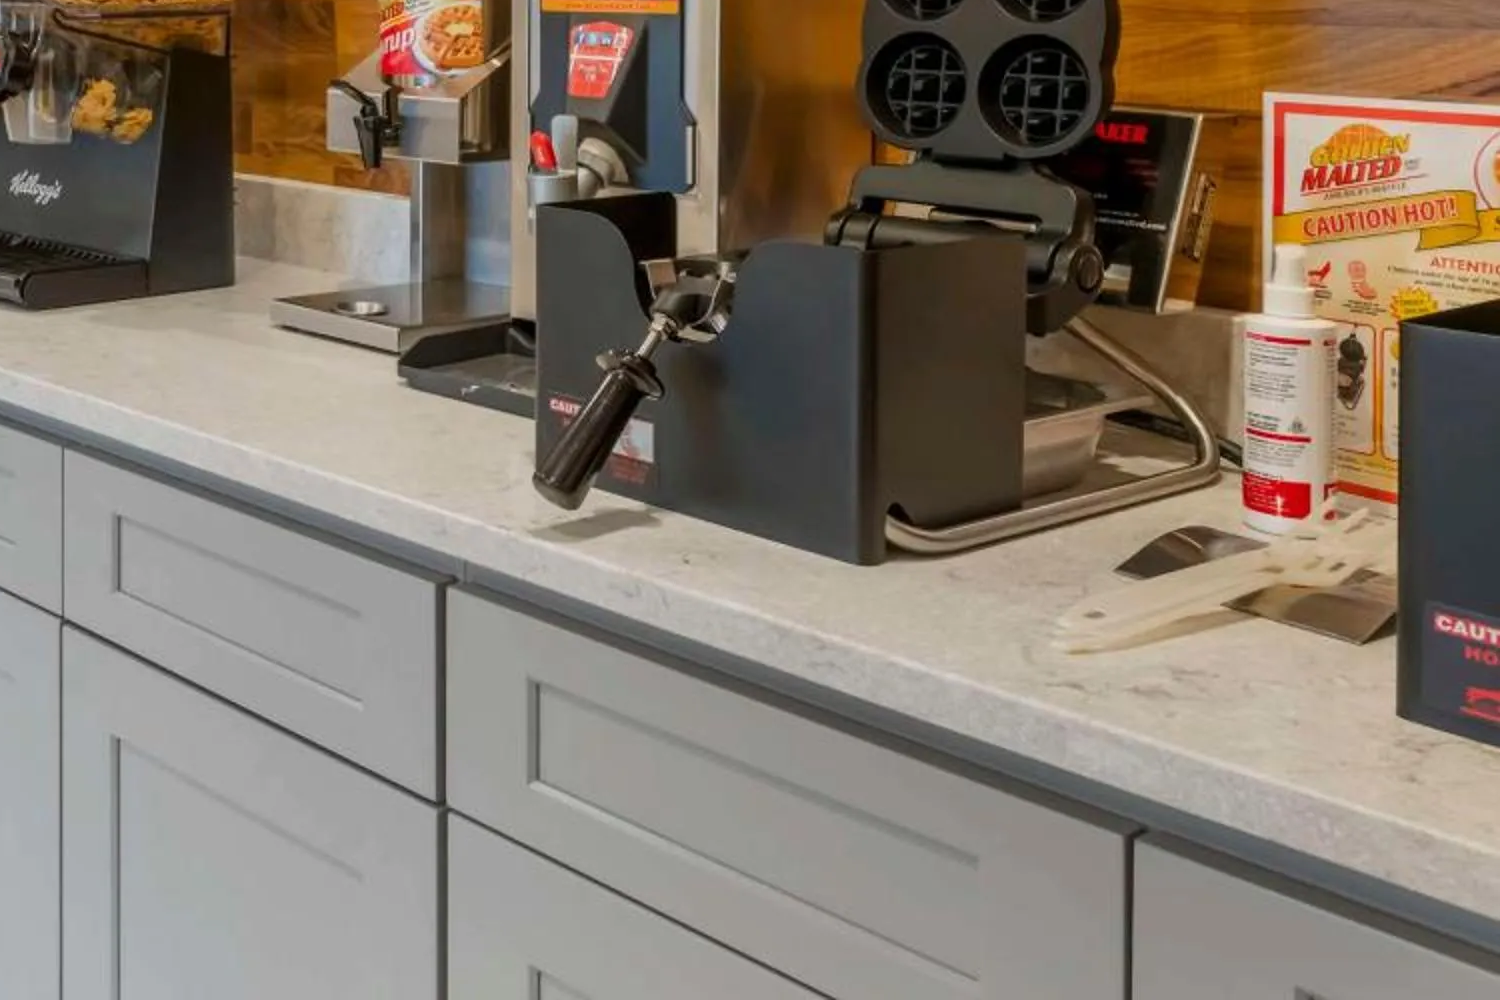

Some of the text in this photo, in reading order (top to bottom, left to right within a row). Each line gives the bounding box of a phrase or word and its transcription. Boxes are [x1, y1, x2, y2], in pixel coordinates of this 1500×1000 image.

[9, 168, 63, 205] Kellogg's
[1301, 155, 1403, 192] MALTED
[1303, 197, 1457, 238] CAUTION HOT!
[1435, 614, 1500, 644] CAUT
